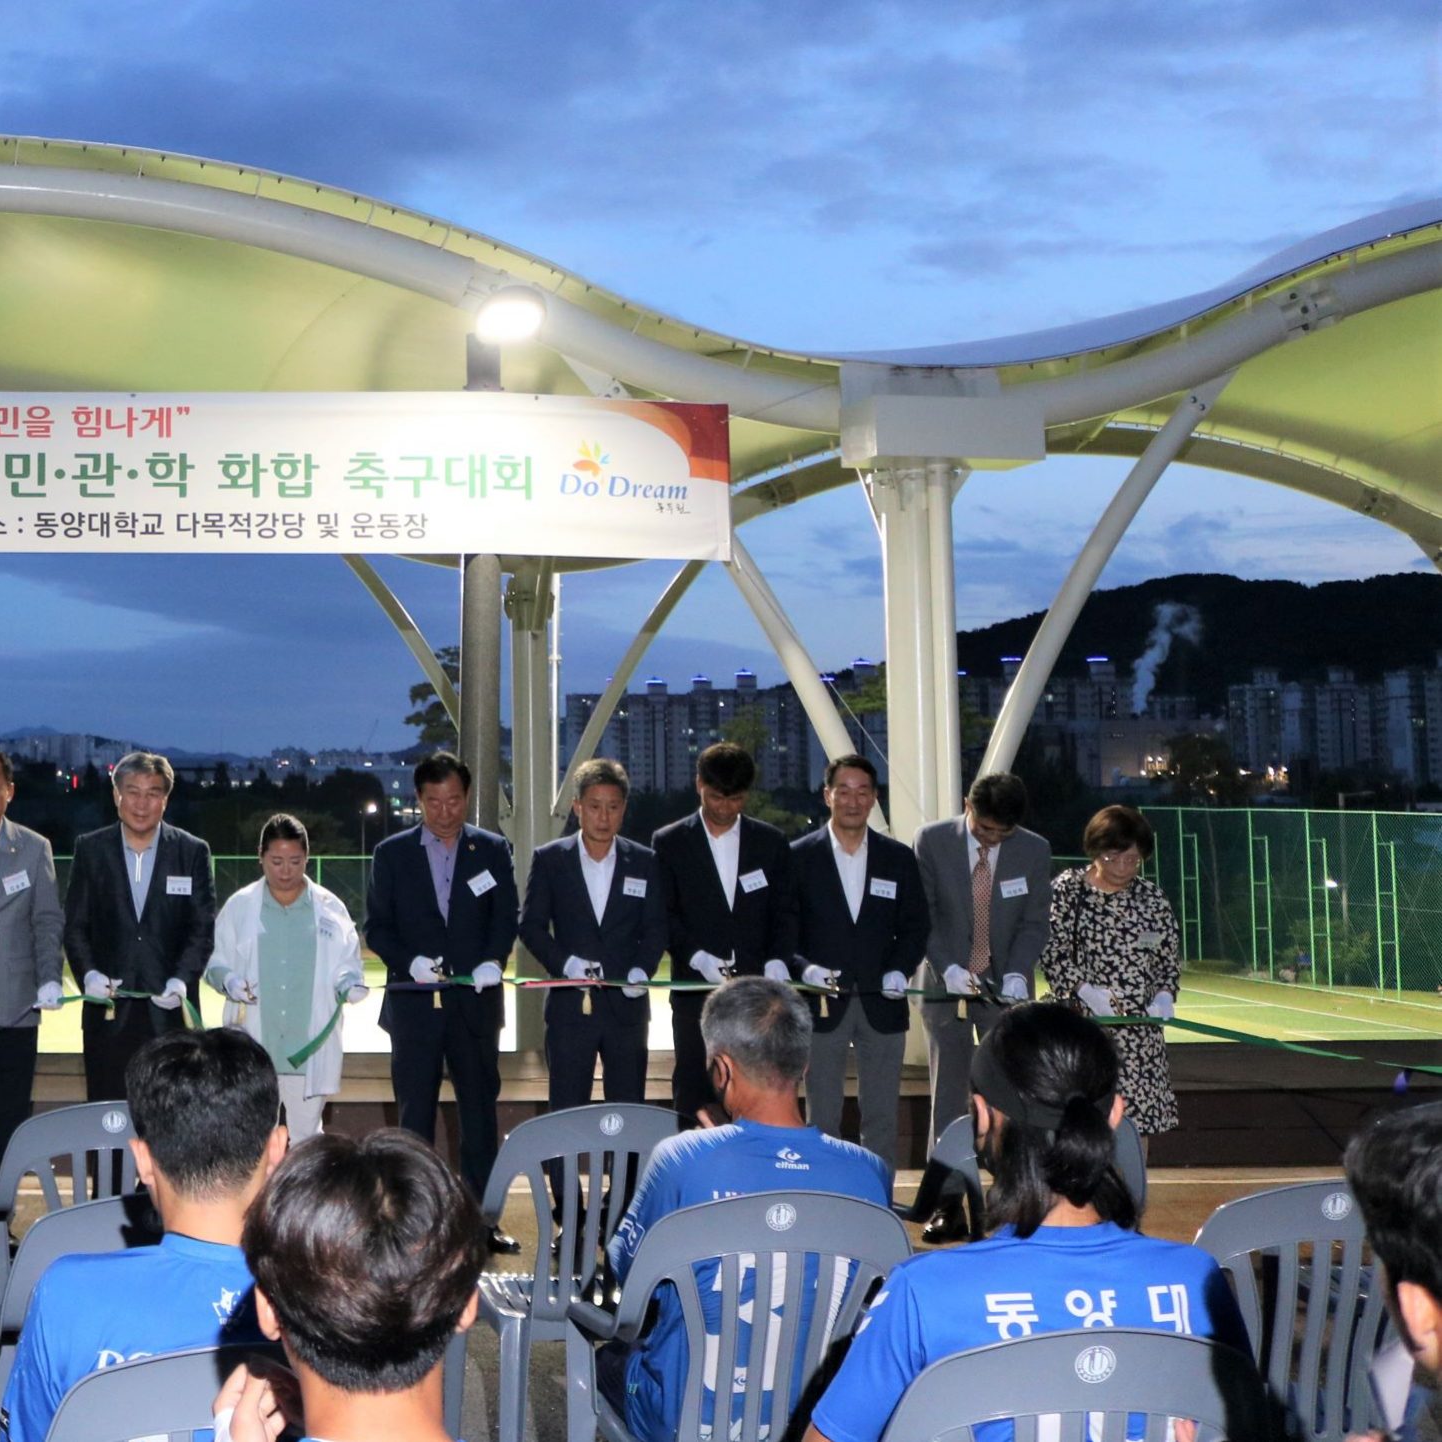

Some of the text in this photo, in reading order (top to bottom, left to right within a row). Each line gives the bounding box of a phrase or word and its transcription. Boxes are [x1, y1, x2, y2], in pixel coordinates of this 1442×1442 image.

[71, 405, 191, 439] 힘나게”
[217, 452, 321, 499] 화합
[343, 452, 533, 500] 축구대회
[608, 476, 688, 500] Dream
[33, 511, 165, 539] 동양대학교
[176, 512, 306, 539] 다목적강당
[316, 513, 340, 539] 및
[350, 513, 429, 540] 운동장
